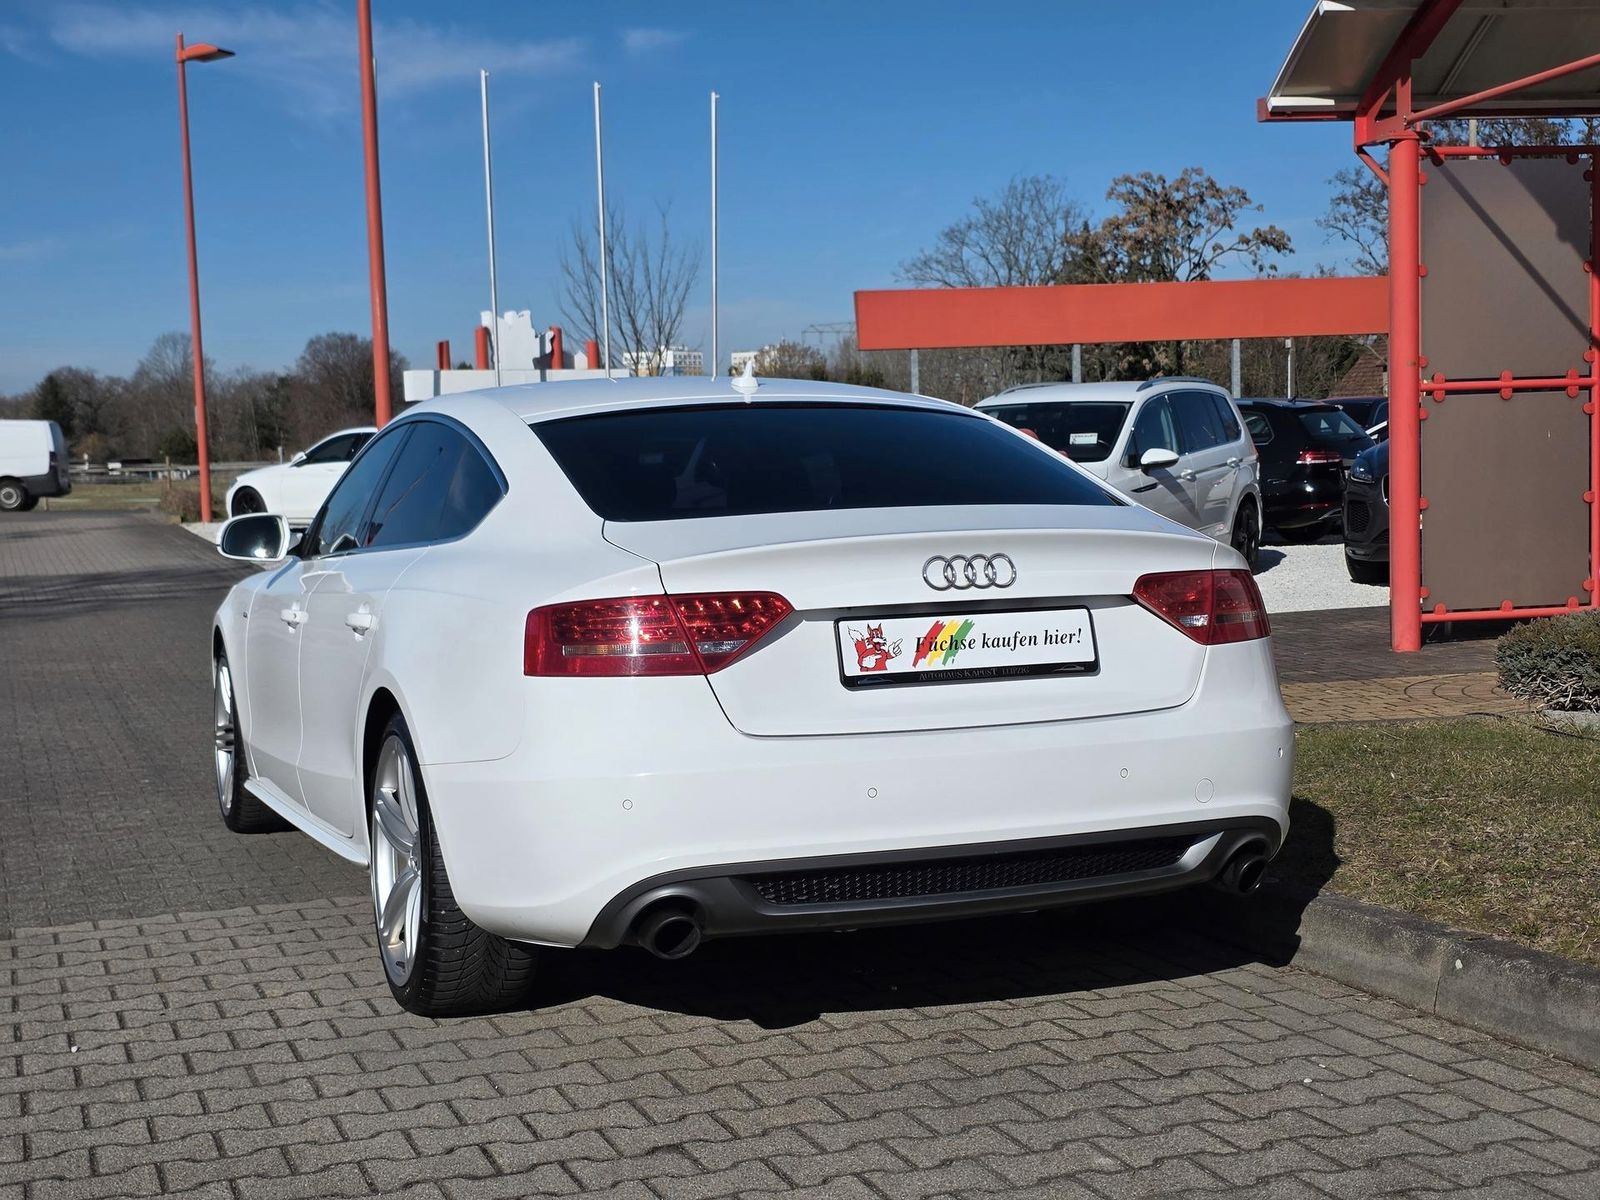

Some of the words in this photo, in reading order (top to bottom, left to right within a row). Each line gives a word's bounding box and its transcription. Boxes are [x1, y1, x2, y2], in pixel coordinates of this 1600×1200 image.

[915, 634, 976, 653] Füchse
[982, 631, 1038, 651] kaufen
[1043, 628, 1082, 646] hier!
[919, 670, 963, 681] AUTOHAUS
